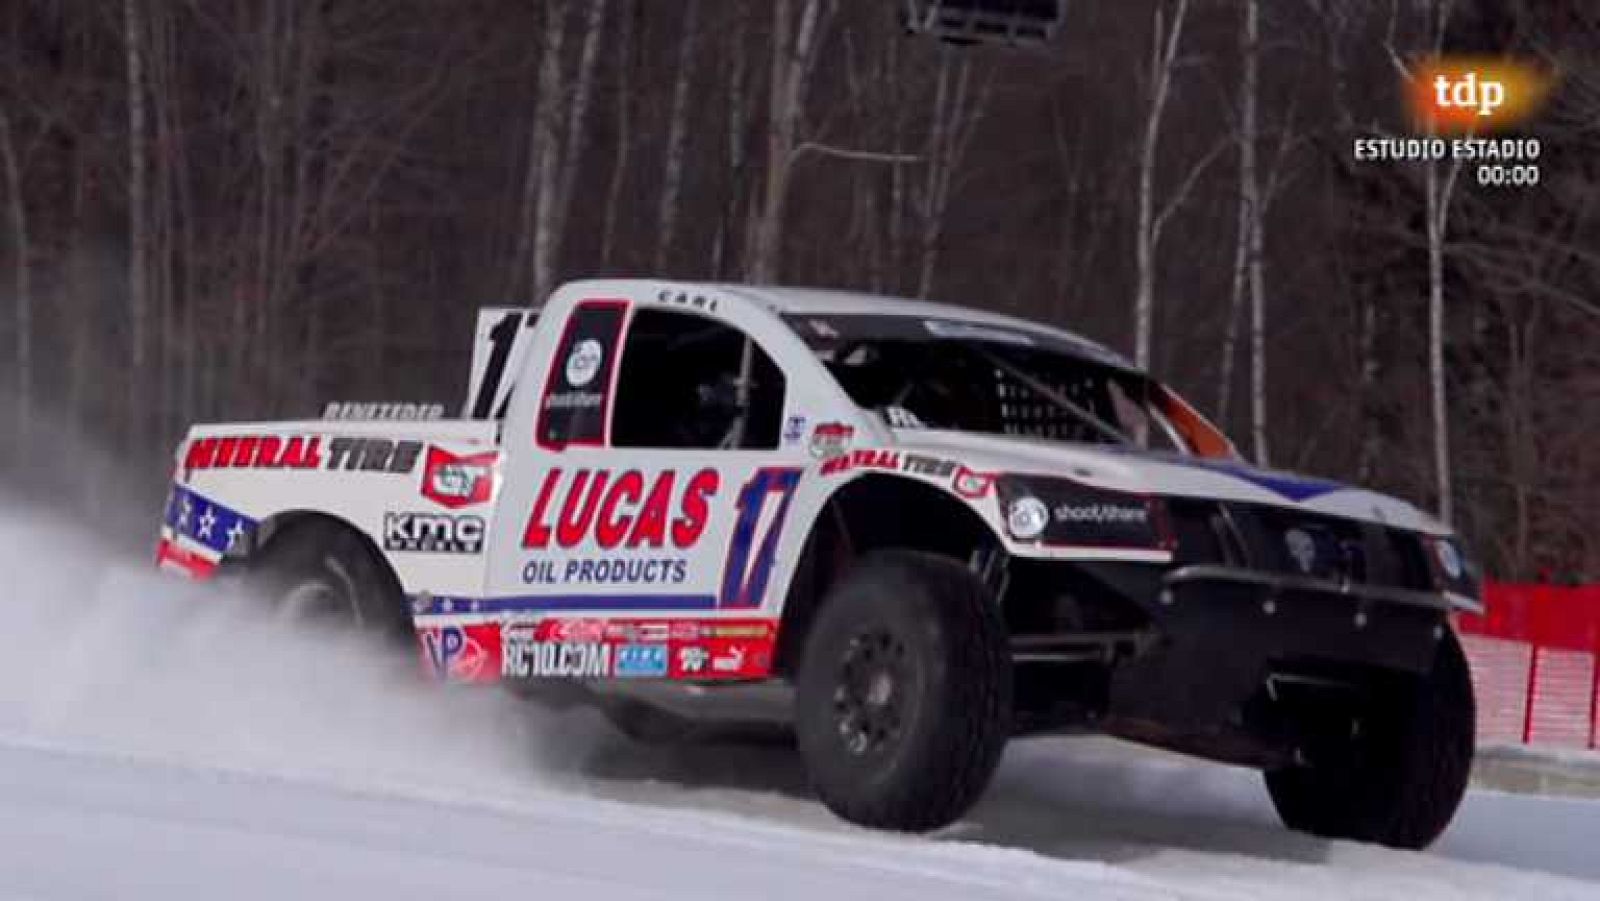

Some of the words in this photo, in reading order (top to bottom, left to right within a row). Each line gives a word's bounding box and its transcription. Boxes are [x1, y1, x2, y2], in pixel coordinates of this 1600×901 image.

[657, 290, 719, 312] CARL
[328, 437, 424, 473] TIRE
[521, 467, 721, 549] LUCAS
[719, 466, 804, 609] 17
[522, 560, 556, 584] OIL
[564, 559, 687, 584] PRODUCTS
